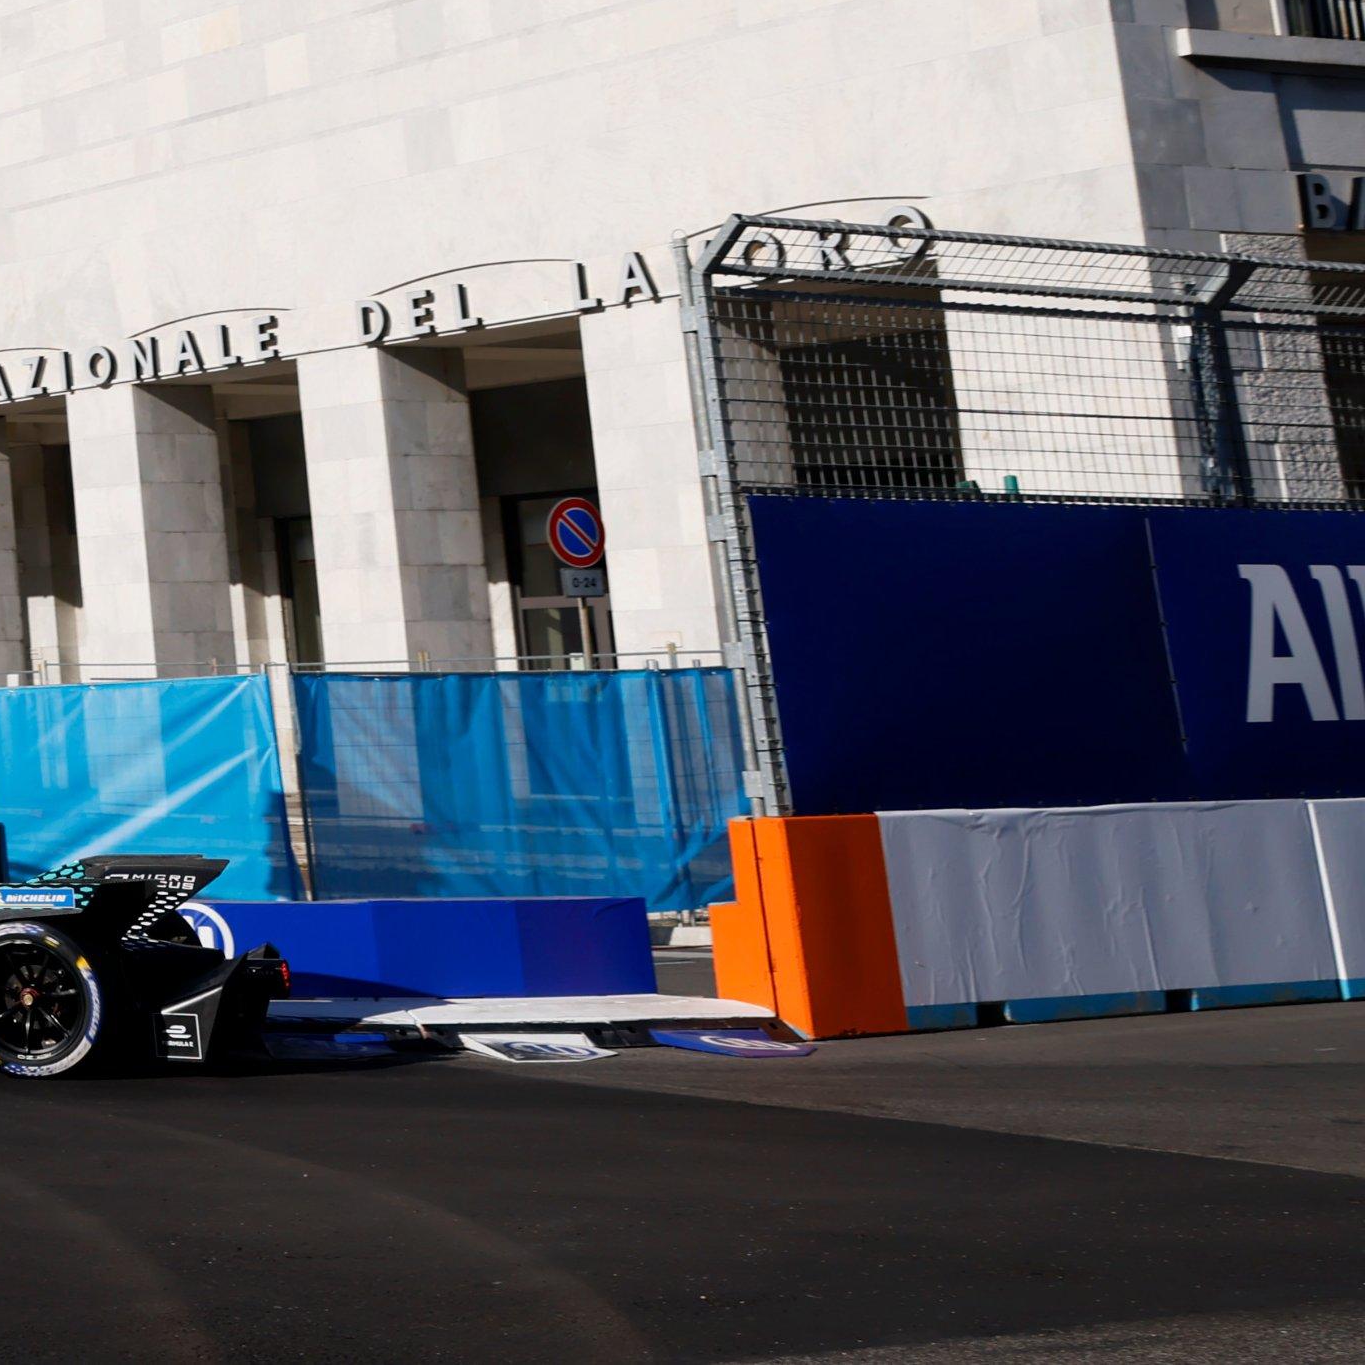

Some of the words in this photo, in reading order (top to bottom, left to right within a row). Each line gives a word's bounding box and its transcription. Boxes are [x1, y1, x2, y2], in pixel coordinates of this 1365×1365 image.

[356, 284, 482, 344] DEL
[571, 206, 935, 314] LAORO
[572, 577, 597, 589] 0-24
[1238, 564, 1365, 723] Al
[5, 894, 67, 903] MICHELIN
